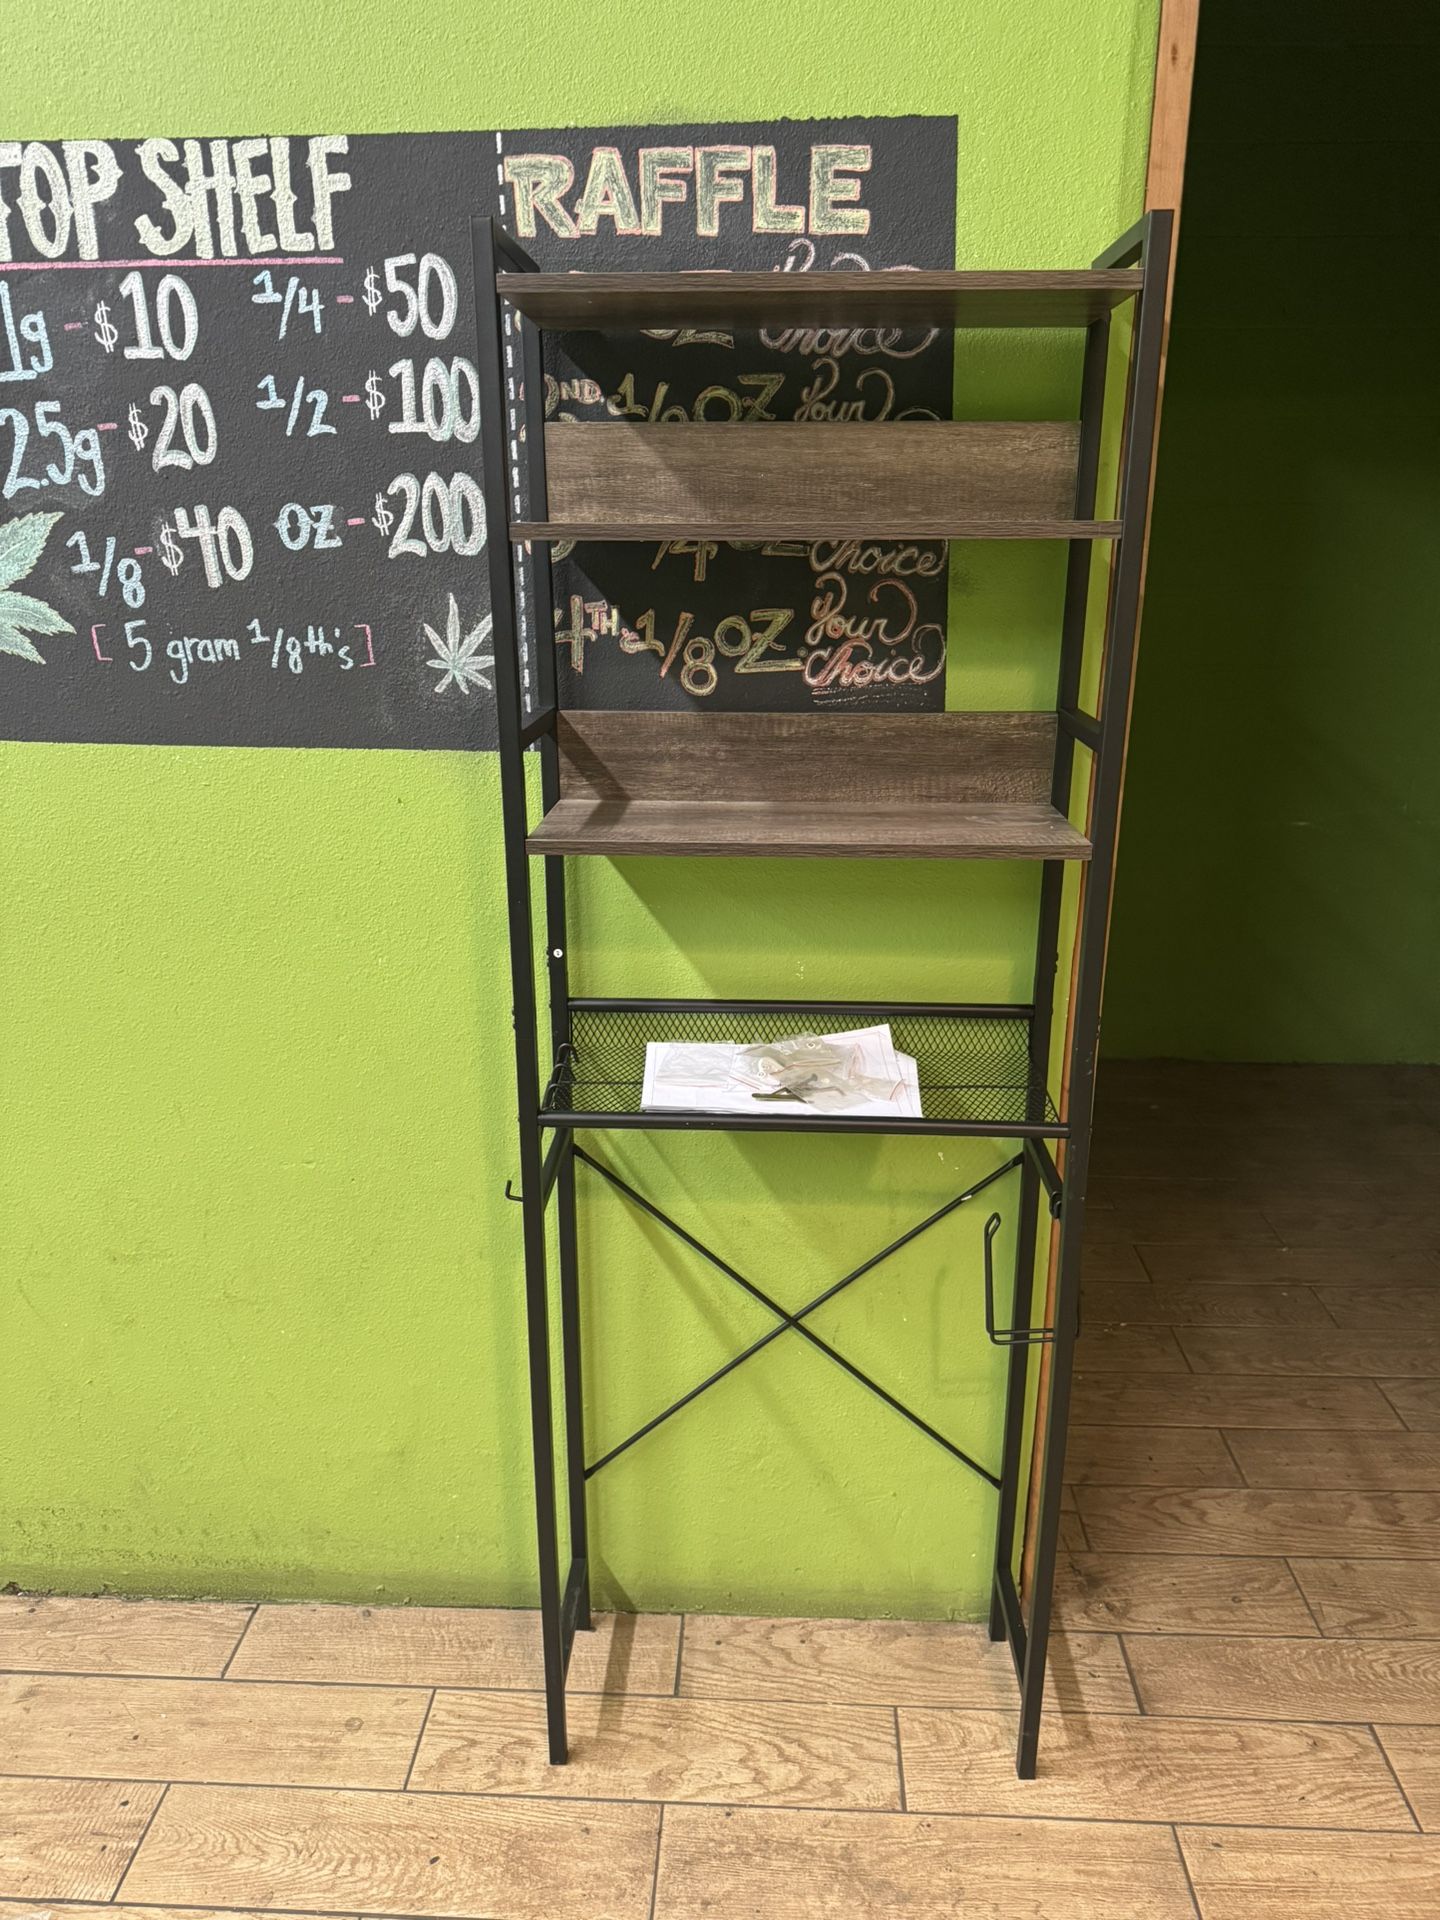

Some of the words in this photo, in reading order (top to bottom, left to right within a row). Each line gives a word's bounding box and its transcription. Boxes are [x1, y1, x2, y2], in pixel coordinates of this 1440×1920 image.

[134, 134, 352, 260] SHELF
[504, 144, 872, 239] RAFFLE
[0, 280, 54, 382] 1g
[94, 271, 198, 361] $10
[251, 270, 325, 340] 1/4
[362, 252, 458, 340] $50
[0, 400, 105, 500] 2.5g
[128, 383, 217, 472] $20
[255, 374, 338, 436] 1/2
[364, 356, 481, 443] $100
[66, 531, 146, 608] 1/8
[159, 504, 254, 588] $40
[273, 502, 343, 551] OZ
[372, 471, 488, 559] $200
[124, 620, 152, 672] 5
[166, 636, 241, 684] gram
[619, 608, 718, 697] 1/8
[803, 638, 947, 688] Choice
